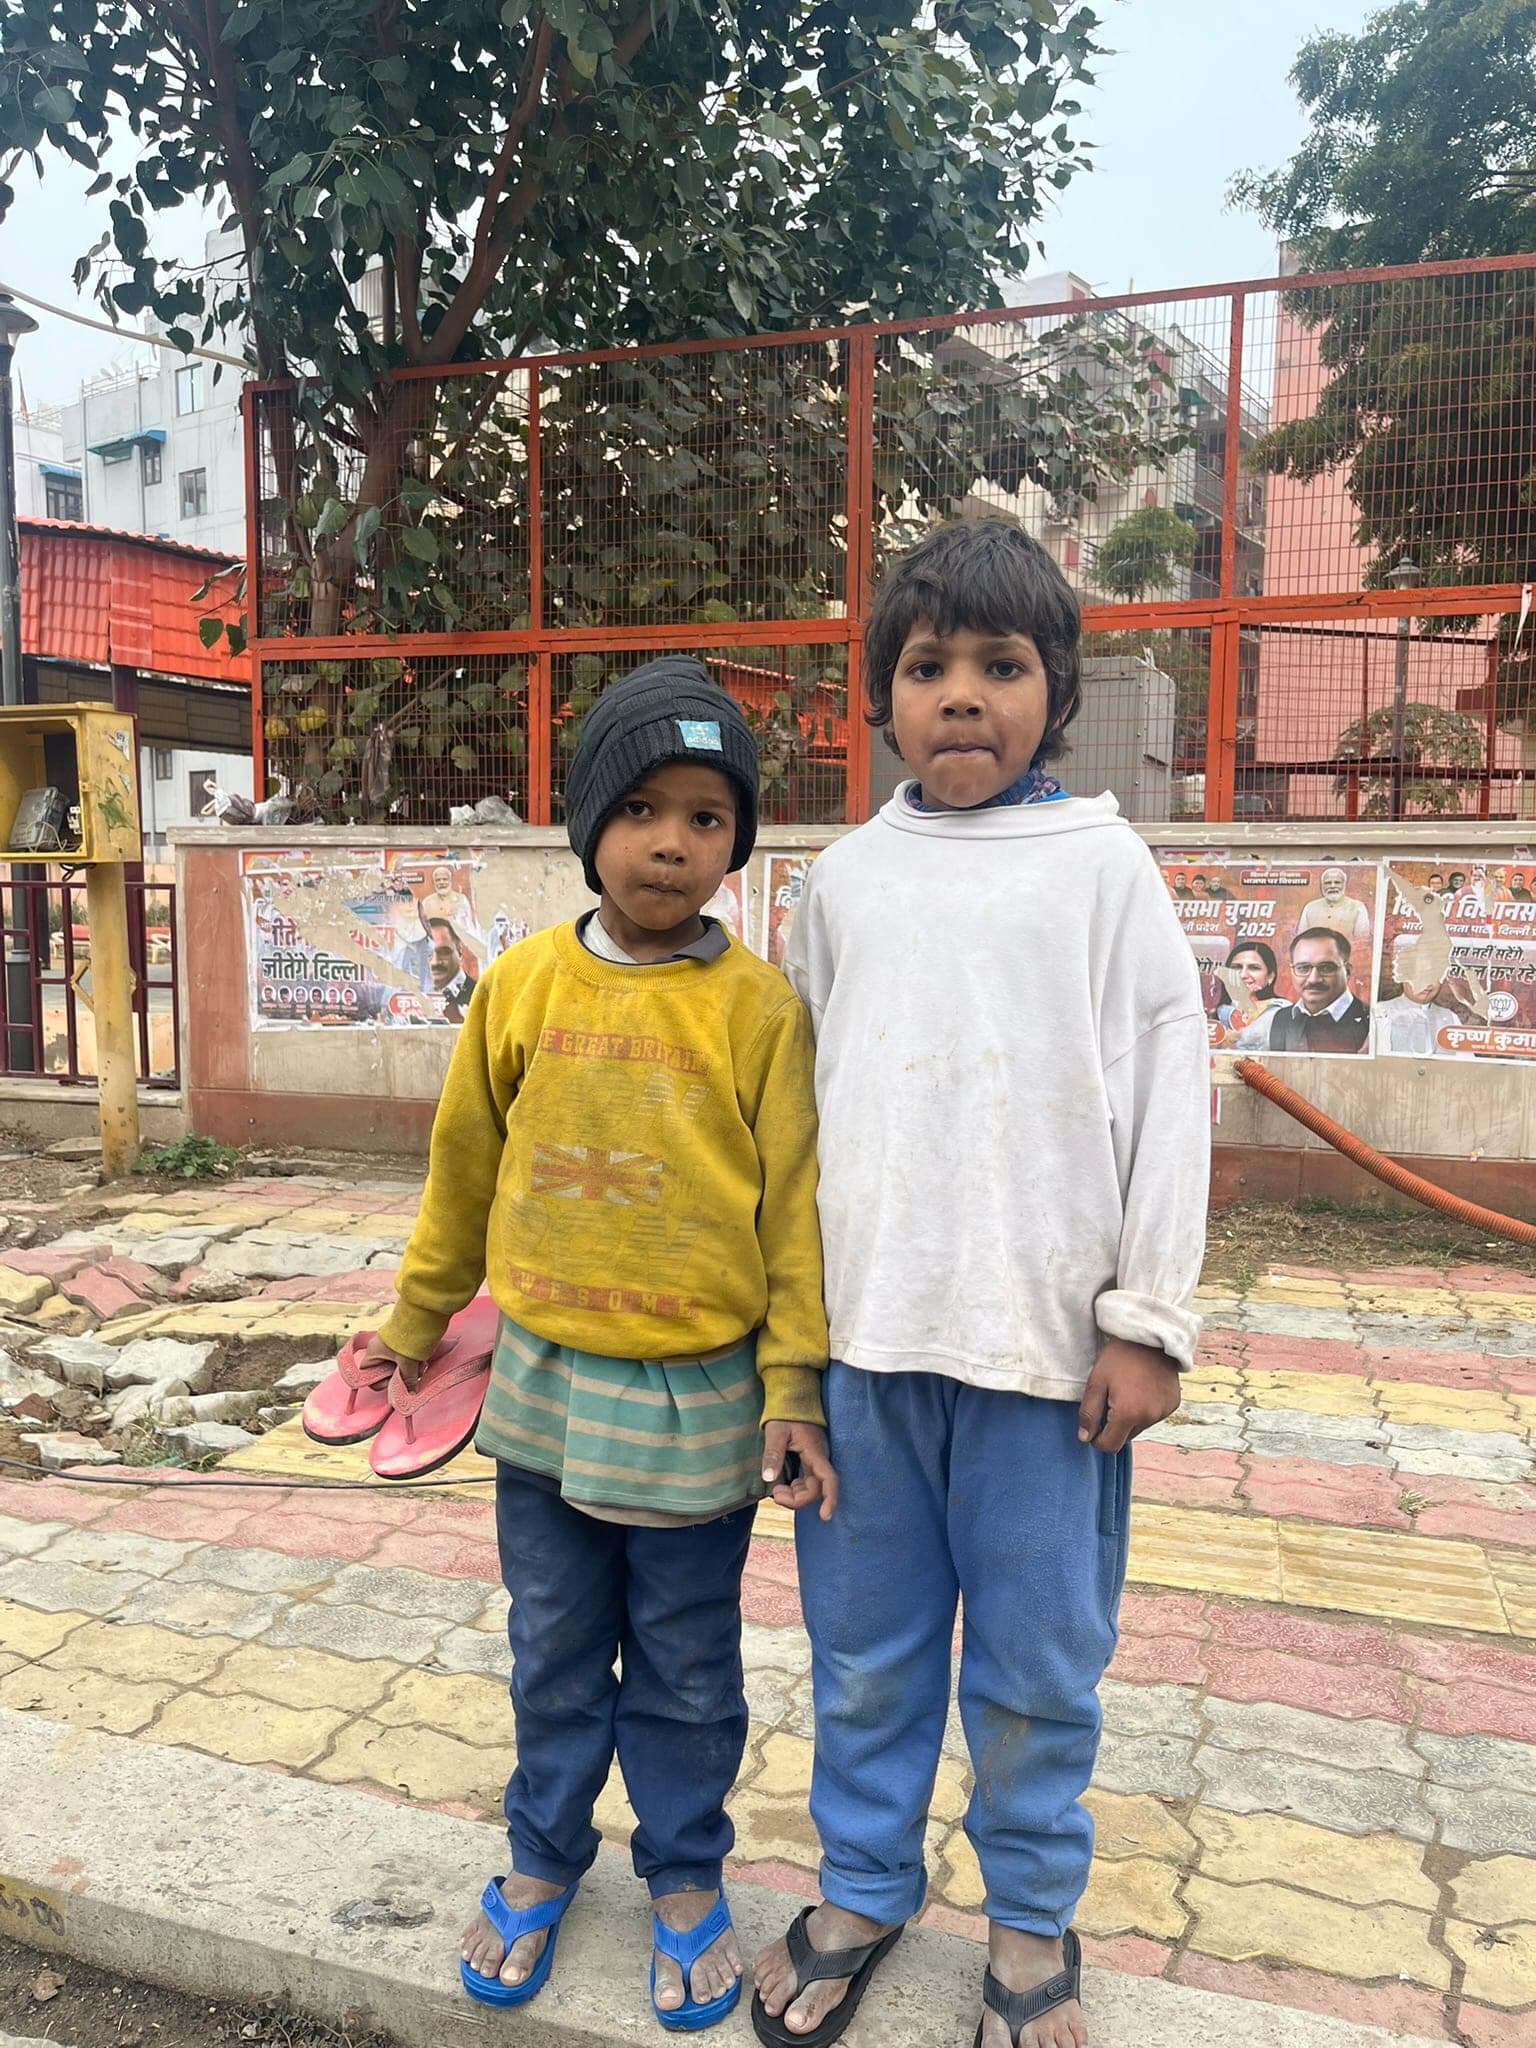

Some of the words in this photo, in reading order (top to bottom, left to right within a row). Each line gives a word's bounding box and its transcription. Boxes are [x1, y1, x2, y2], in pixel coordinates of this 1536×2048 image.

[1225, 901, 1276, 926] चुनाव
[1237, 922, 1276, 937] 2025
[1472, 945, 1497, 958] नहीं
[262, 952, 309, 979] जीतेंगे
[1490, 966, 1515, 980] कर
[561, 1032, 623, 1057] GREAT
[1446, 1028, 1493, 1048] कृष्ण
